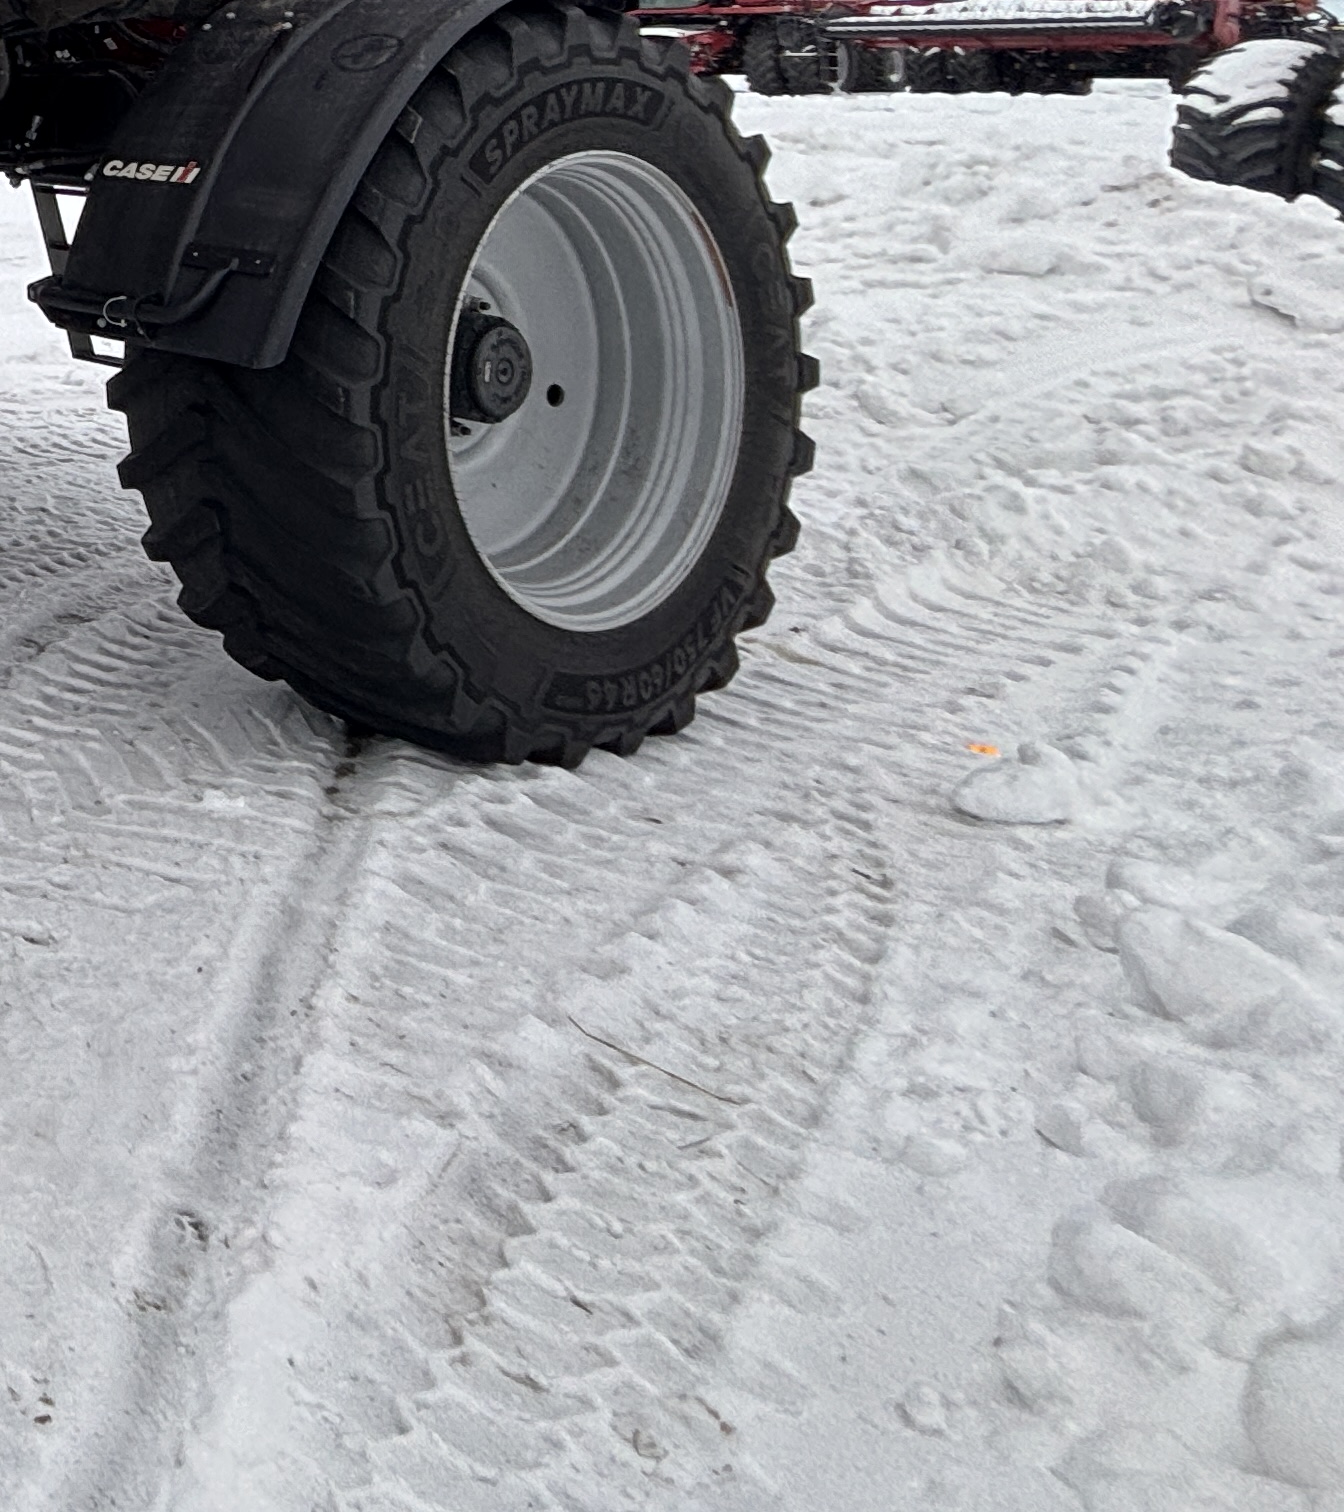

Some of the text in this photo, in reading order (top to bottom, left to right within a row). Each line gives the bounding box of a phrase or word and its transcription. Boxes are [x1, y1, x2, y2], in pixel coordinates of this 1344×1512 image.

[484, 82, 653, 175] SPRAYMAX
[398, 391, 444, 556] CEAT
[710, 586, 736, 633] VF
